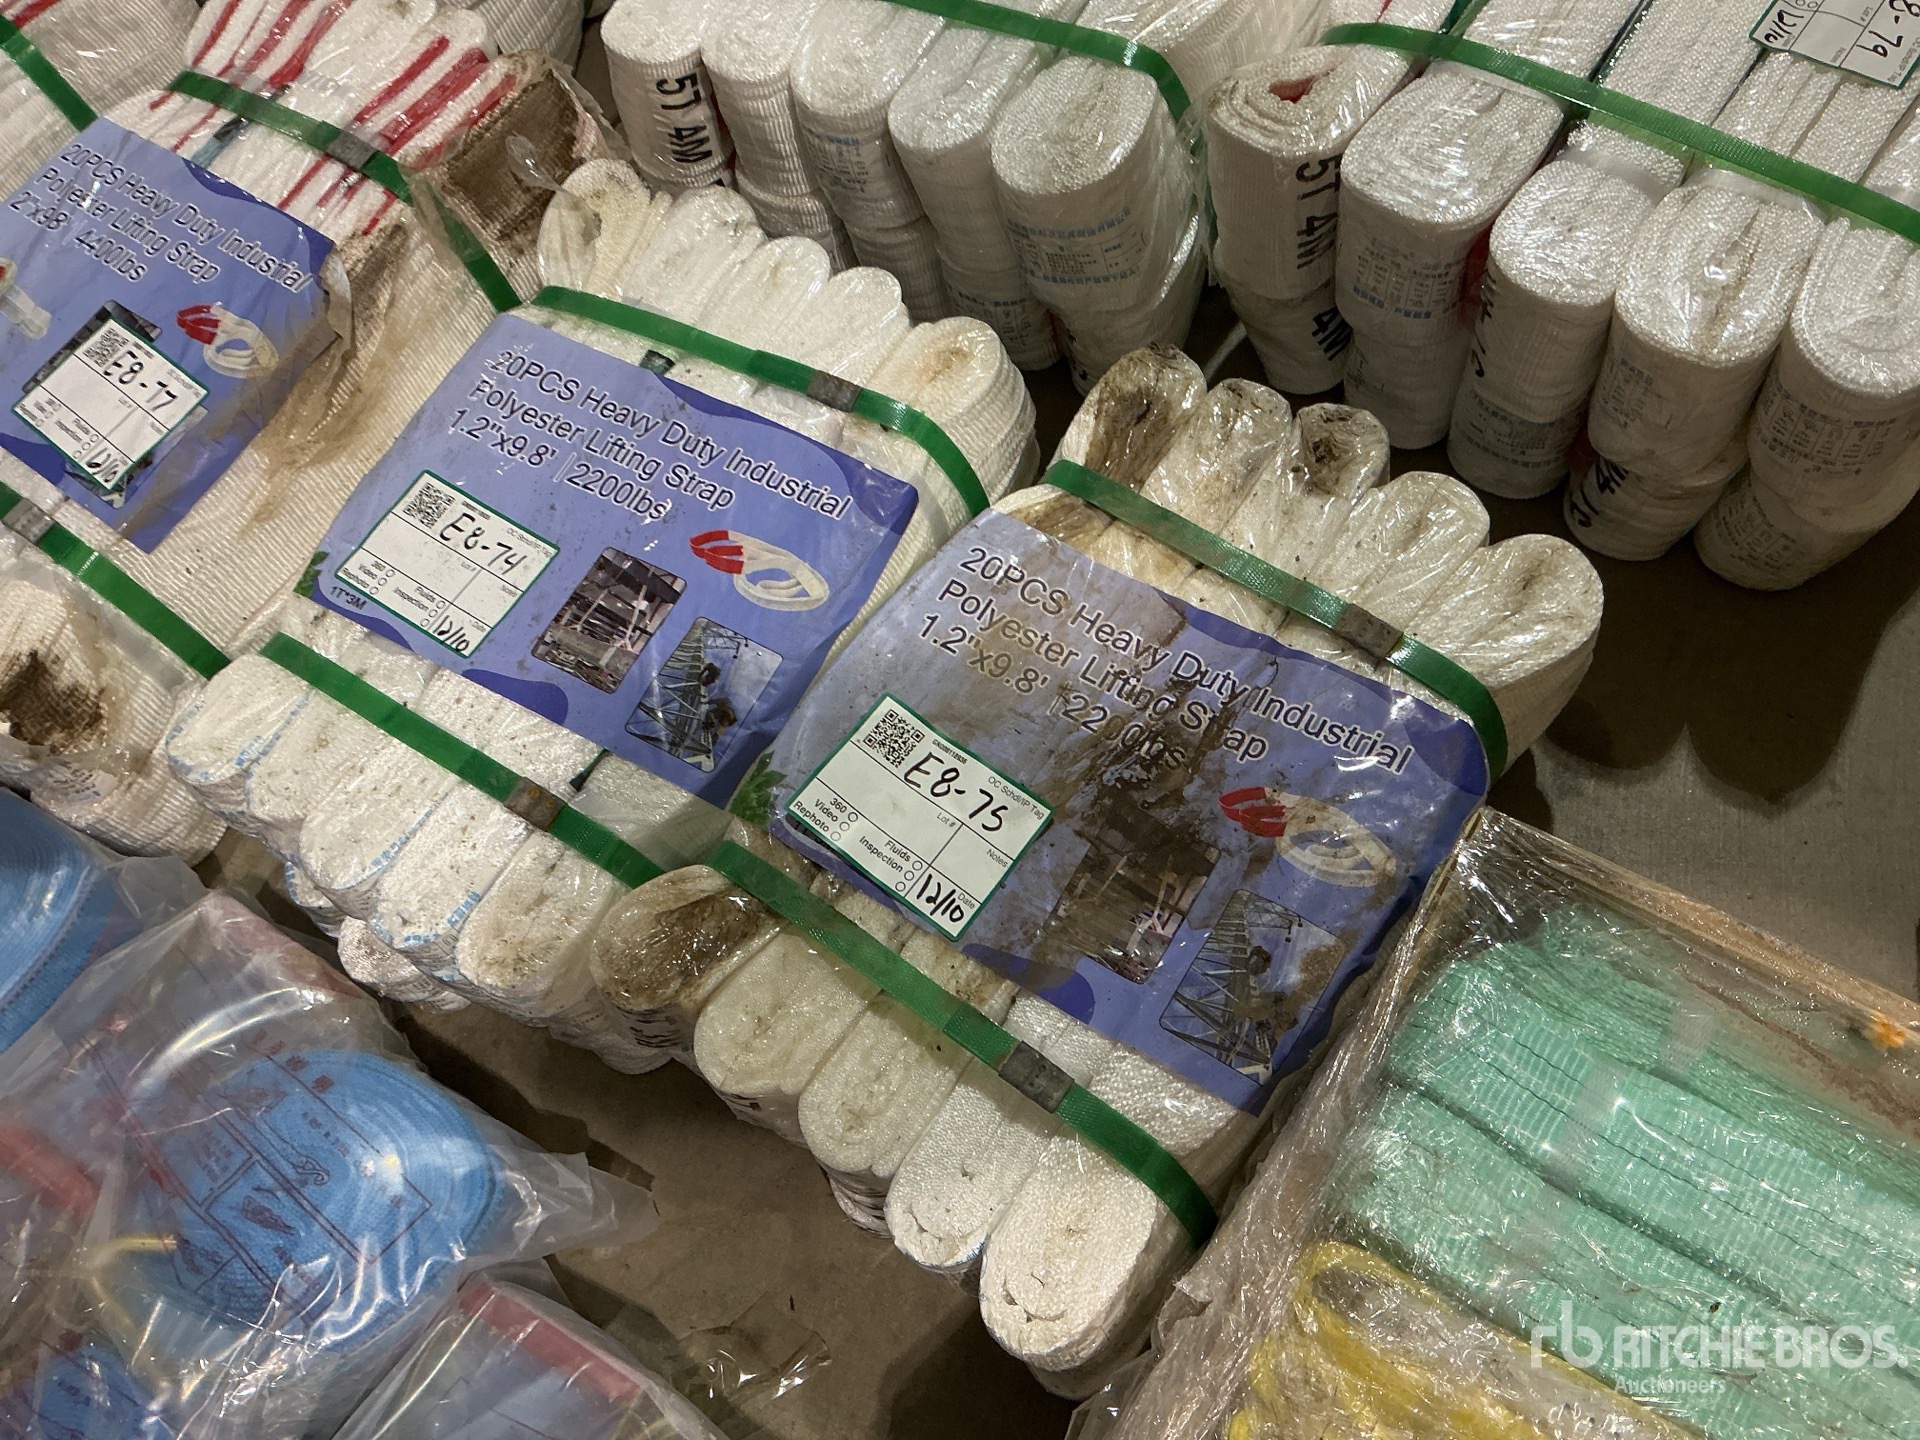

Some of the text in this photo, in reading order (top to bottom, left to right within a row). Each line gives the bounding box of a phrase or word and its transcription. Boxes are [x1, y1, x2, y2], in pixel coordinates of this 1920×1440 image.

[60, 144, 314, 293] 20PCS Heavy Duty Industrial
[109, 208, 171, 256] Lifting
[165, 240, 221, 284] Strap
[75, 229, 148, 281] 4400lbs
[103, 350, 177, 412] E8-77
[468, 378, 736, 511] Polyester Lifting Strap
[489, 350, 853, 521] 20PCS Heavy Duty Industrial
[565, 462, 669, 520] 2200lbs
[439, 512, 527, 575] E8-74
[937, 579, 1270, 762] Polyester Lifting Stap
[959, 547, 1414, 775] 20PCS Heavy Duty Industrial
[793, 800, 830, 833] Rephoto
[903, 751, 1009, 832] E8-75
[936, 811, 951, 825] Lot
[988, 775, 1003, 790] OC
[1029, 804, 1045, 820] Tag
[814, 798, 839, 823] Video
[859, 836, 904, 873] Inspection
[829, 797, 912, 863] 360 Fluids
[986, 848, 1009, 868] Notes
[916, 874, 965, 923] 12/10
[957, 892, 976, 910] Date
